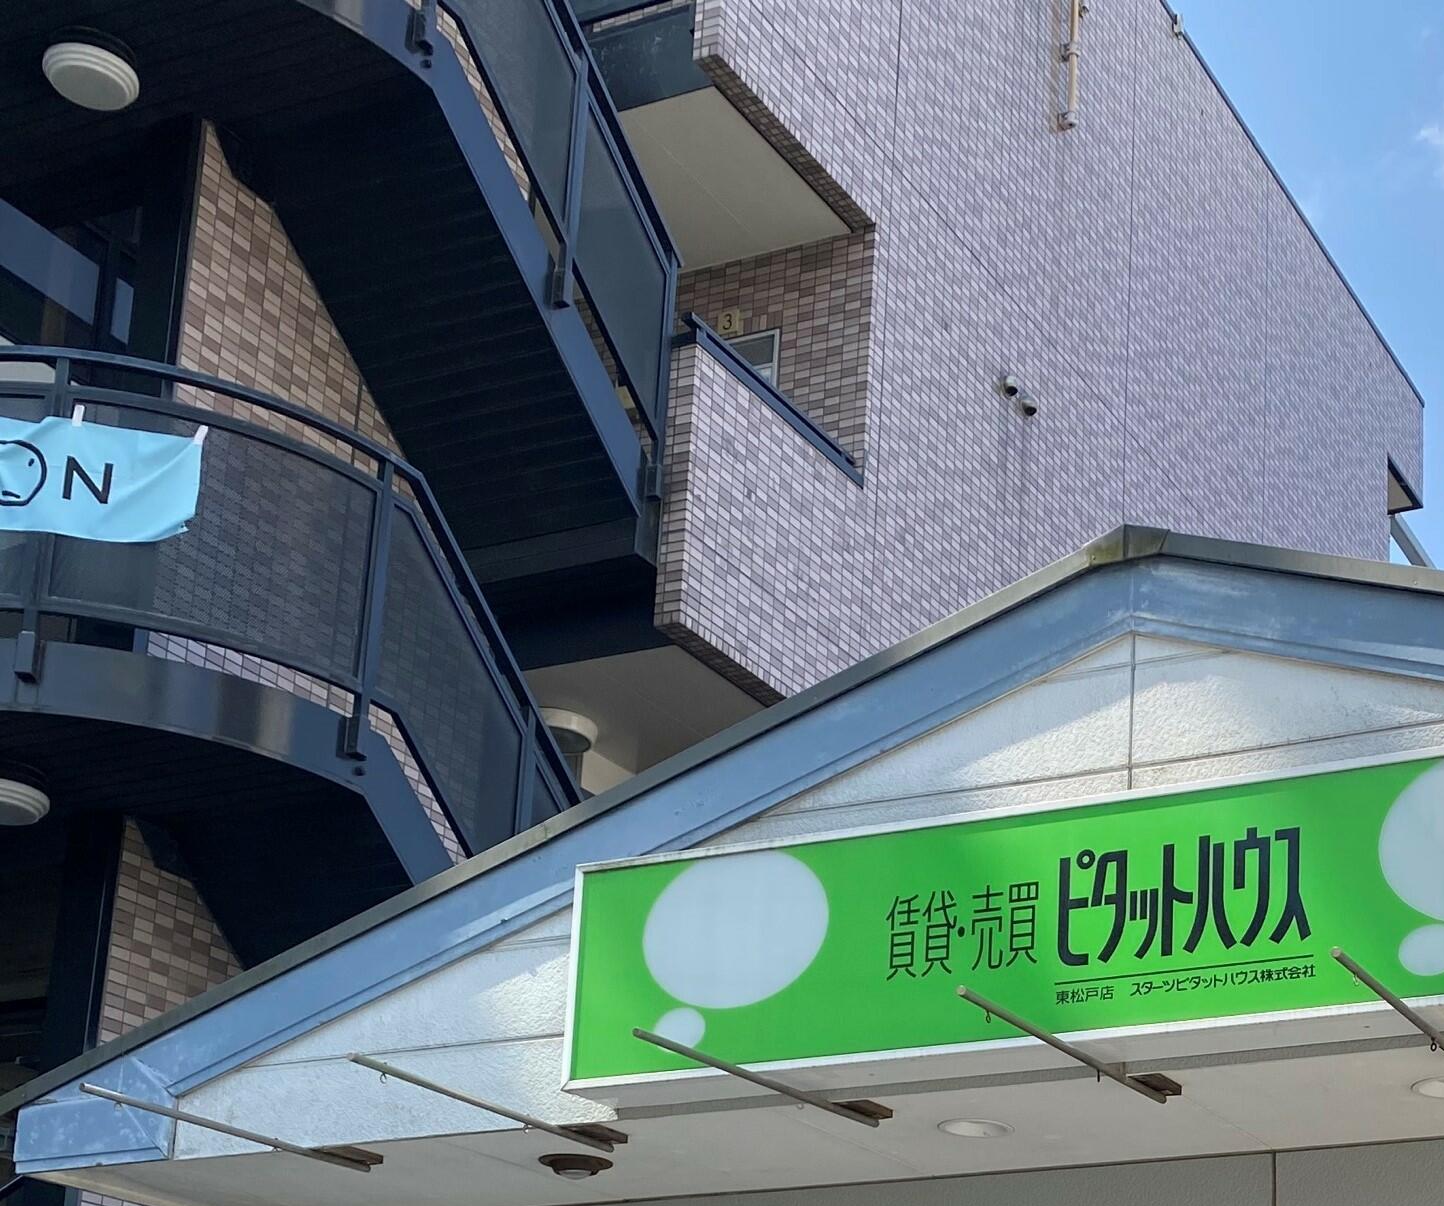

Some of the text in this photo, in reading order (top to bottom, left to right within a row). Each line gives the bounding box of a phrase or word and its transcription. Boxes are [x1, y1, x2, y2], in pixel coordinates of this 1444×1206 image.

[723, 313, 732, 330] 3
[886, 827, 1312, 981] 賃貸・売買 ピタットハウス
[1056, 986, 1115, 1006] 東松戸店
